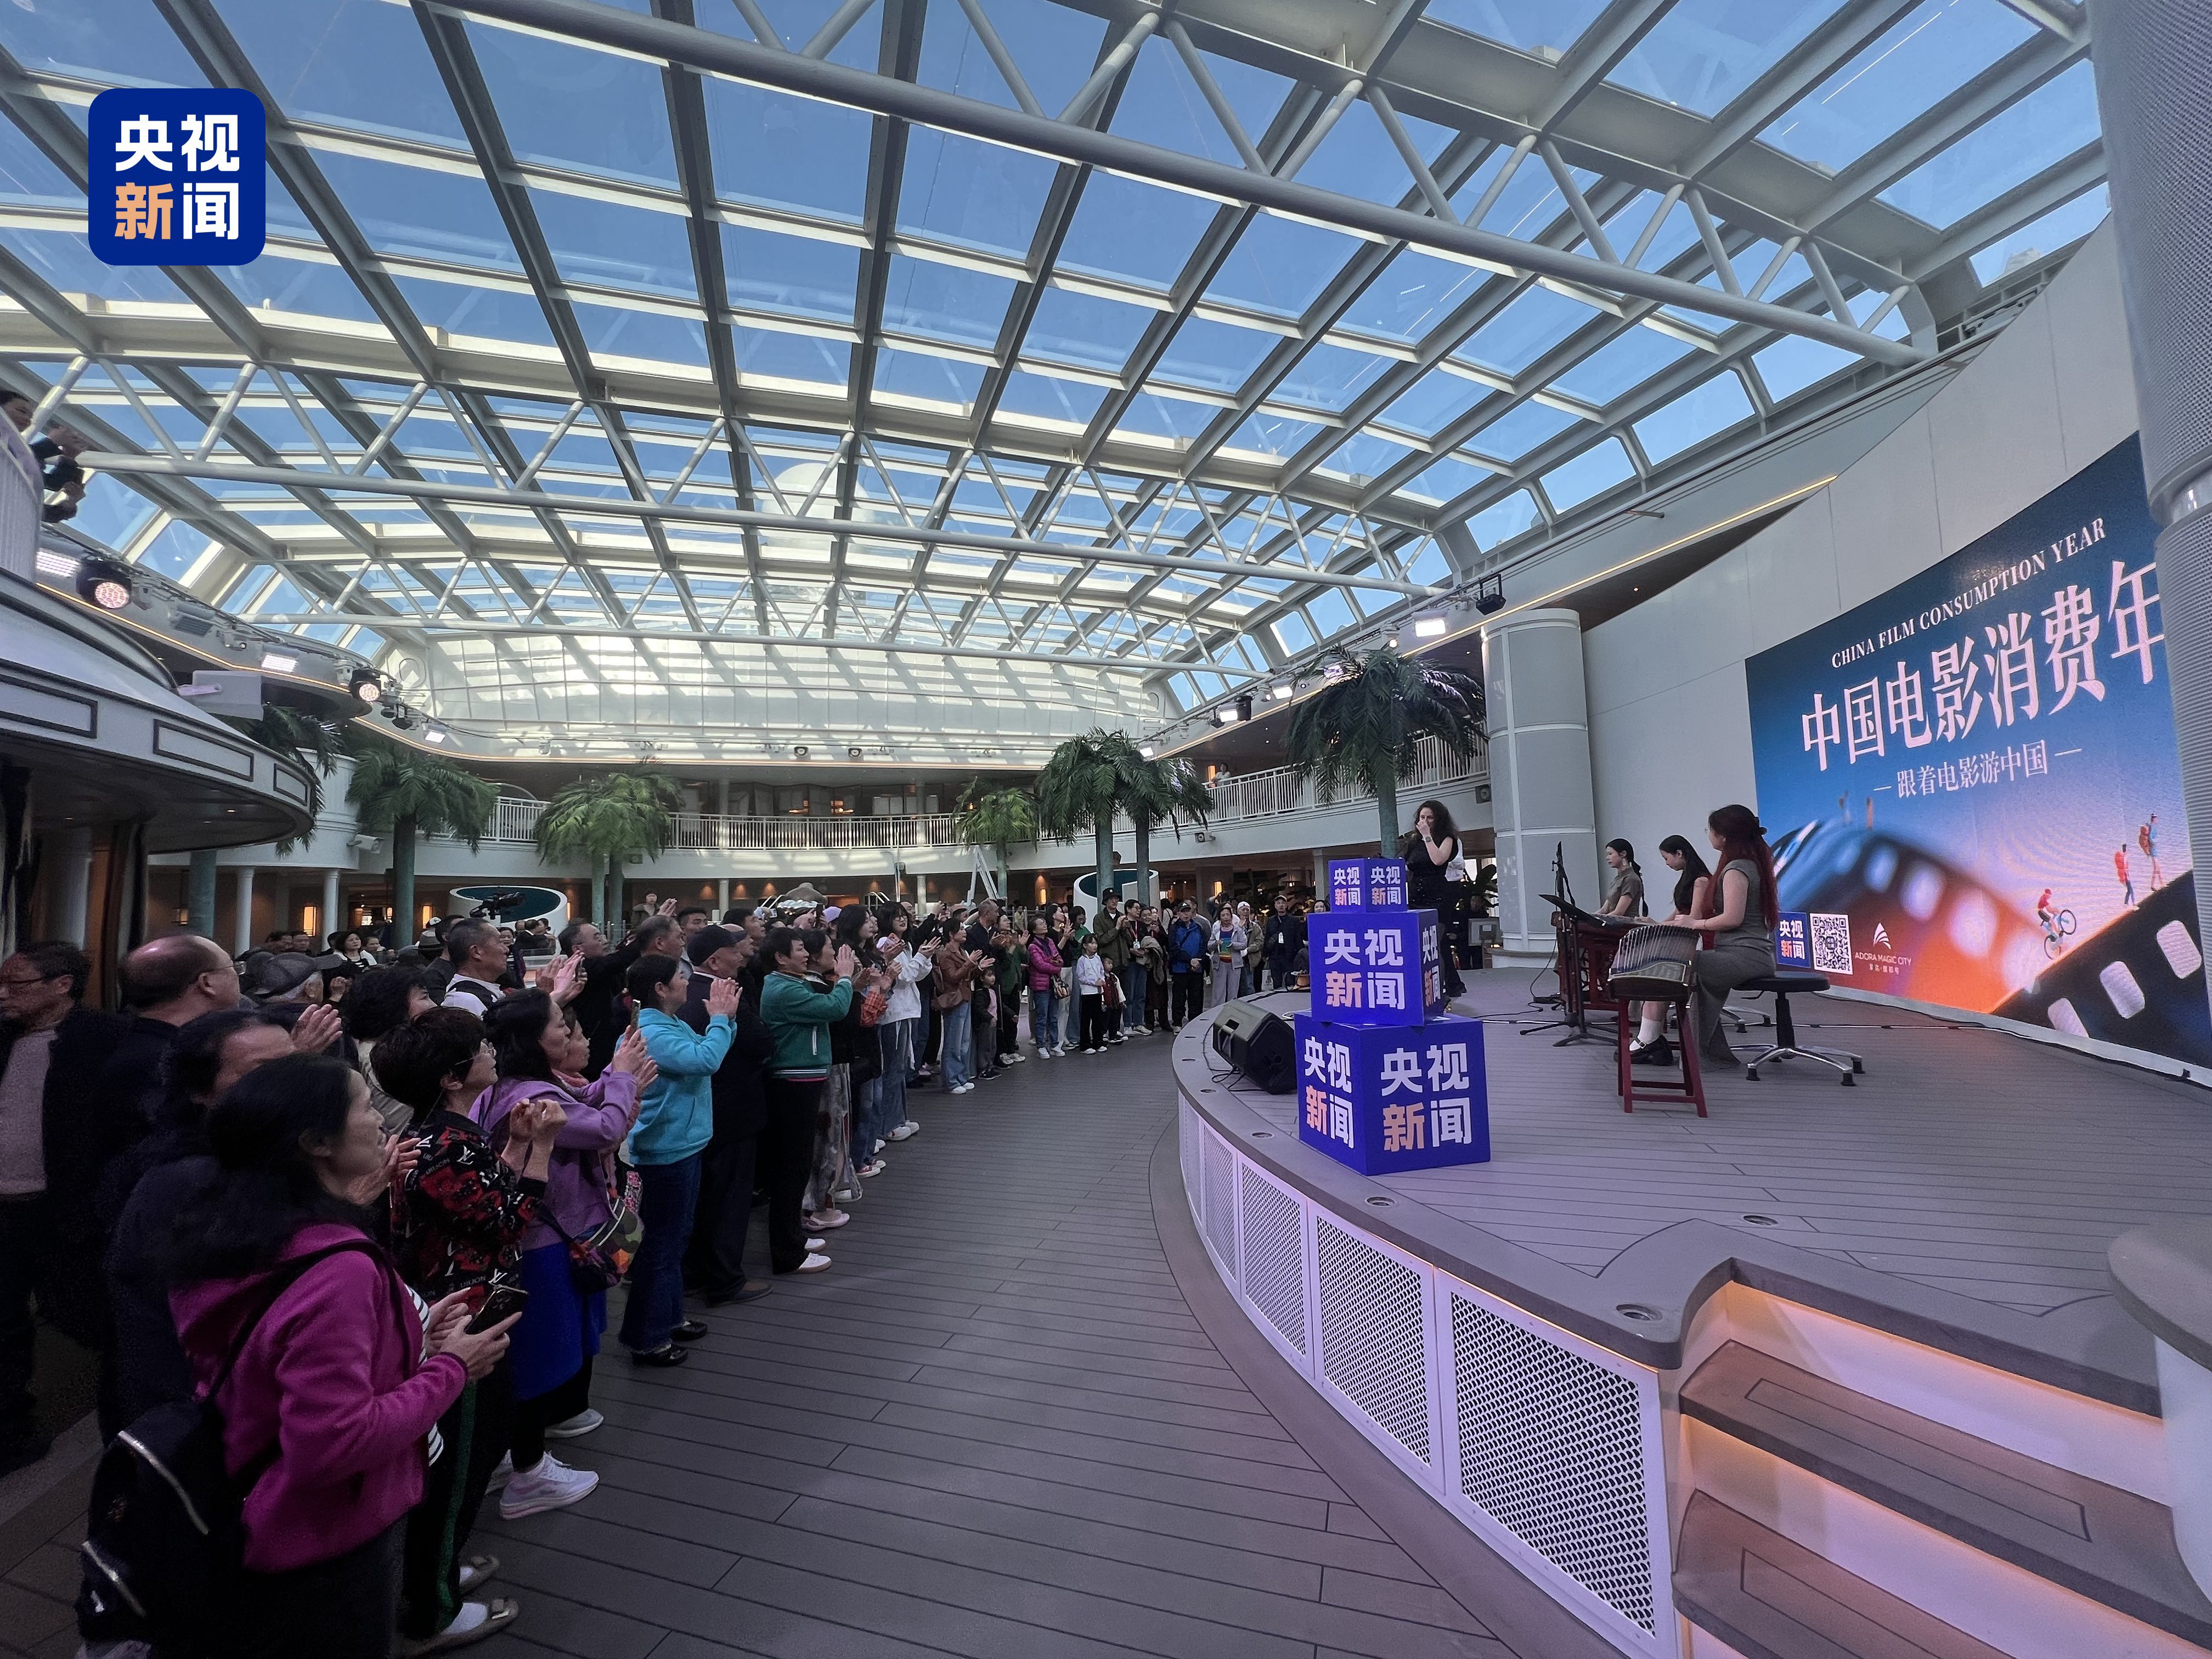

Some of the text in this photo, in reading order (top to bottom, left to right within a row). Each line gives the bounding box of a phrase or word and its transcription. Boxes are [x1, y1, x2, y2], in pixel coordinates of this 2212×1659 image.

[1831, 518, 2107, 669] CHINA FILM CONSUMPTION YEAR
[1802, 560, 2165, 772] 中国电影消费年
[1897, 739, 2048, 799] 跟着电影游中国
[1334, 866, 1361, 885] 央视
[1370, 866, 1401, 885] 央视
[1334, 887, 1361, 906] 新闻
[1371, 887, 1402, 905] 新闻
[1324, 928, 1404, 966] 央视
[1779, 920, 1804, 939] 央视
[1780, 940, 1805, 960] 新闻
[1855, 952, 1912, 966] ADORA MAGIC CITY
[1325, 972, 1406, 1010] 新闻
[1304, 1036, 1352, 1094] 央视
[1380, 1042, 1470, 1097] 央视
[1305, 1085, 1355, 1149] 新闻
[1383, 1097, 1472, 1152] 新闻
